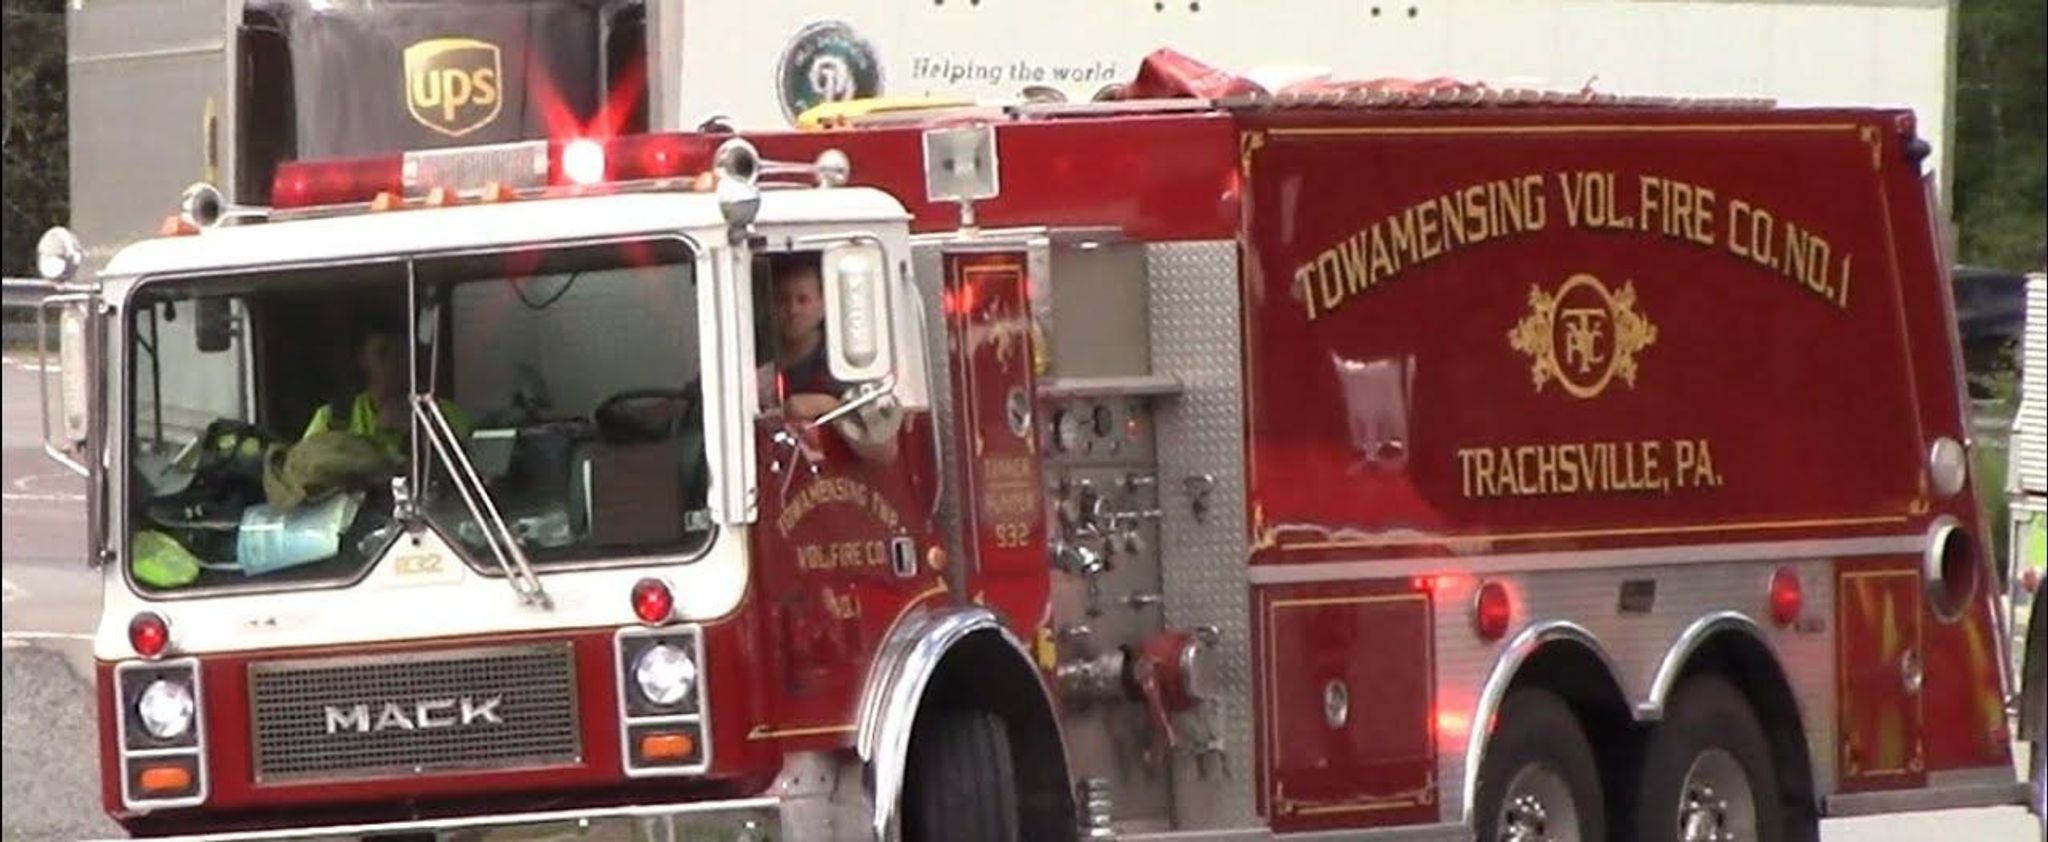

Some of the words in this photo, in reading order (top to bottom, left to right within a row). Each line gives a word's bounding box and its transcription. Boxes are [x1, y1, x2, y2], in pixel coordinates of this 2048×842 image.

[413, 68, 497, 121] ups
[912, 57, 1002, 85] Helping
[1009, 60, 1045, 82] the
[1053, 62, 1117, 83] world
[1294, 174, 1547, 321] TOWAMENSING
[1559, 171, 1635, 229] VOL.
[1639, 175, 1716, 245] FIRE
[1728, 198, 1779, 269] CO.
[1783, 221, 1835, 299] NO.
[1457, 440, 1670, 498] TRACHSVILLE,
[1674, 438, 1724, 488] PA.
[995, 522, 1029, 548] 932
[324, 693, 504, 735] MACK
